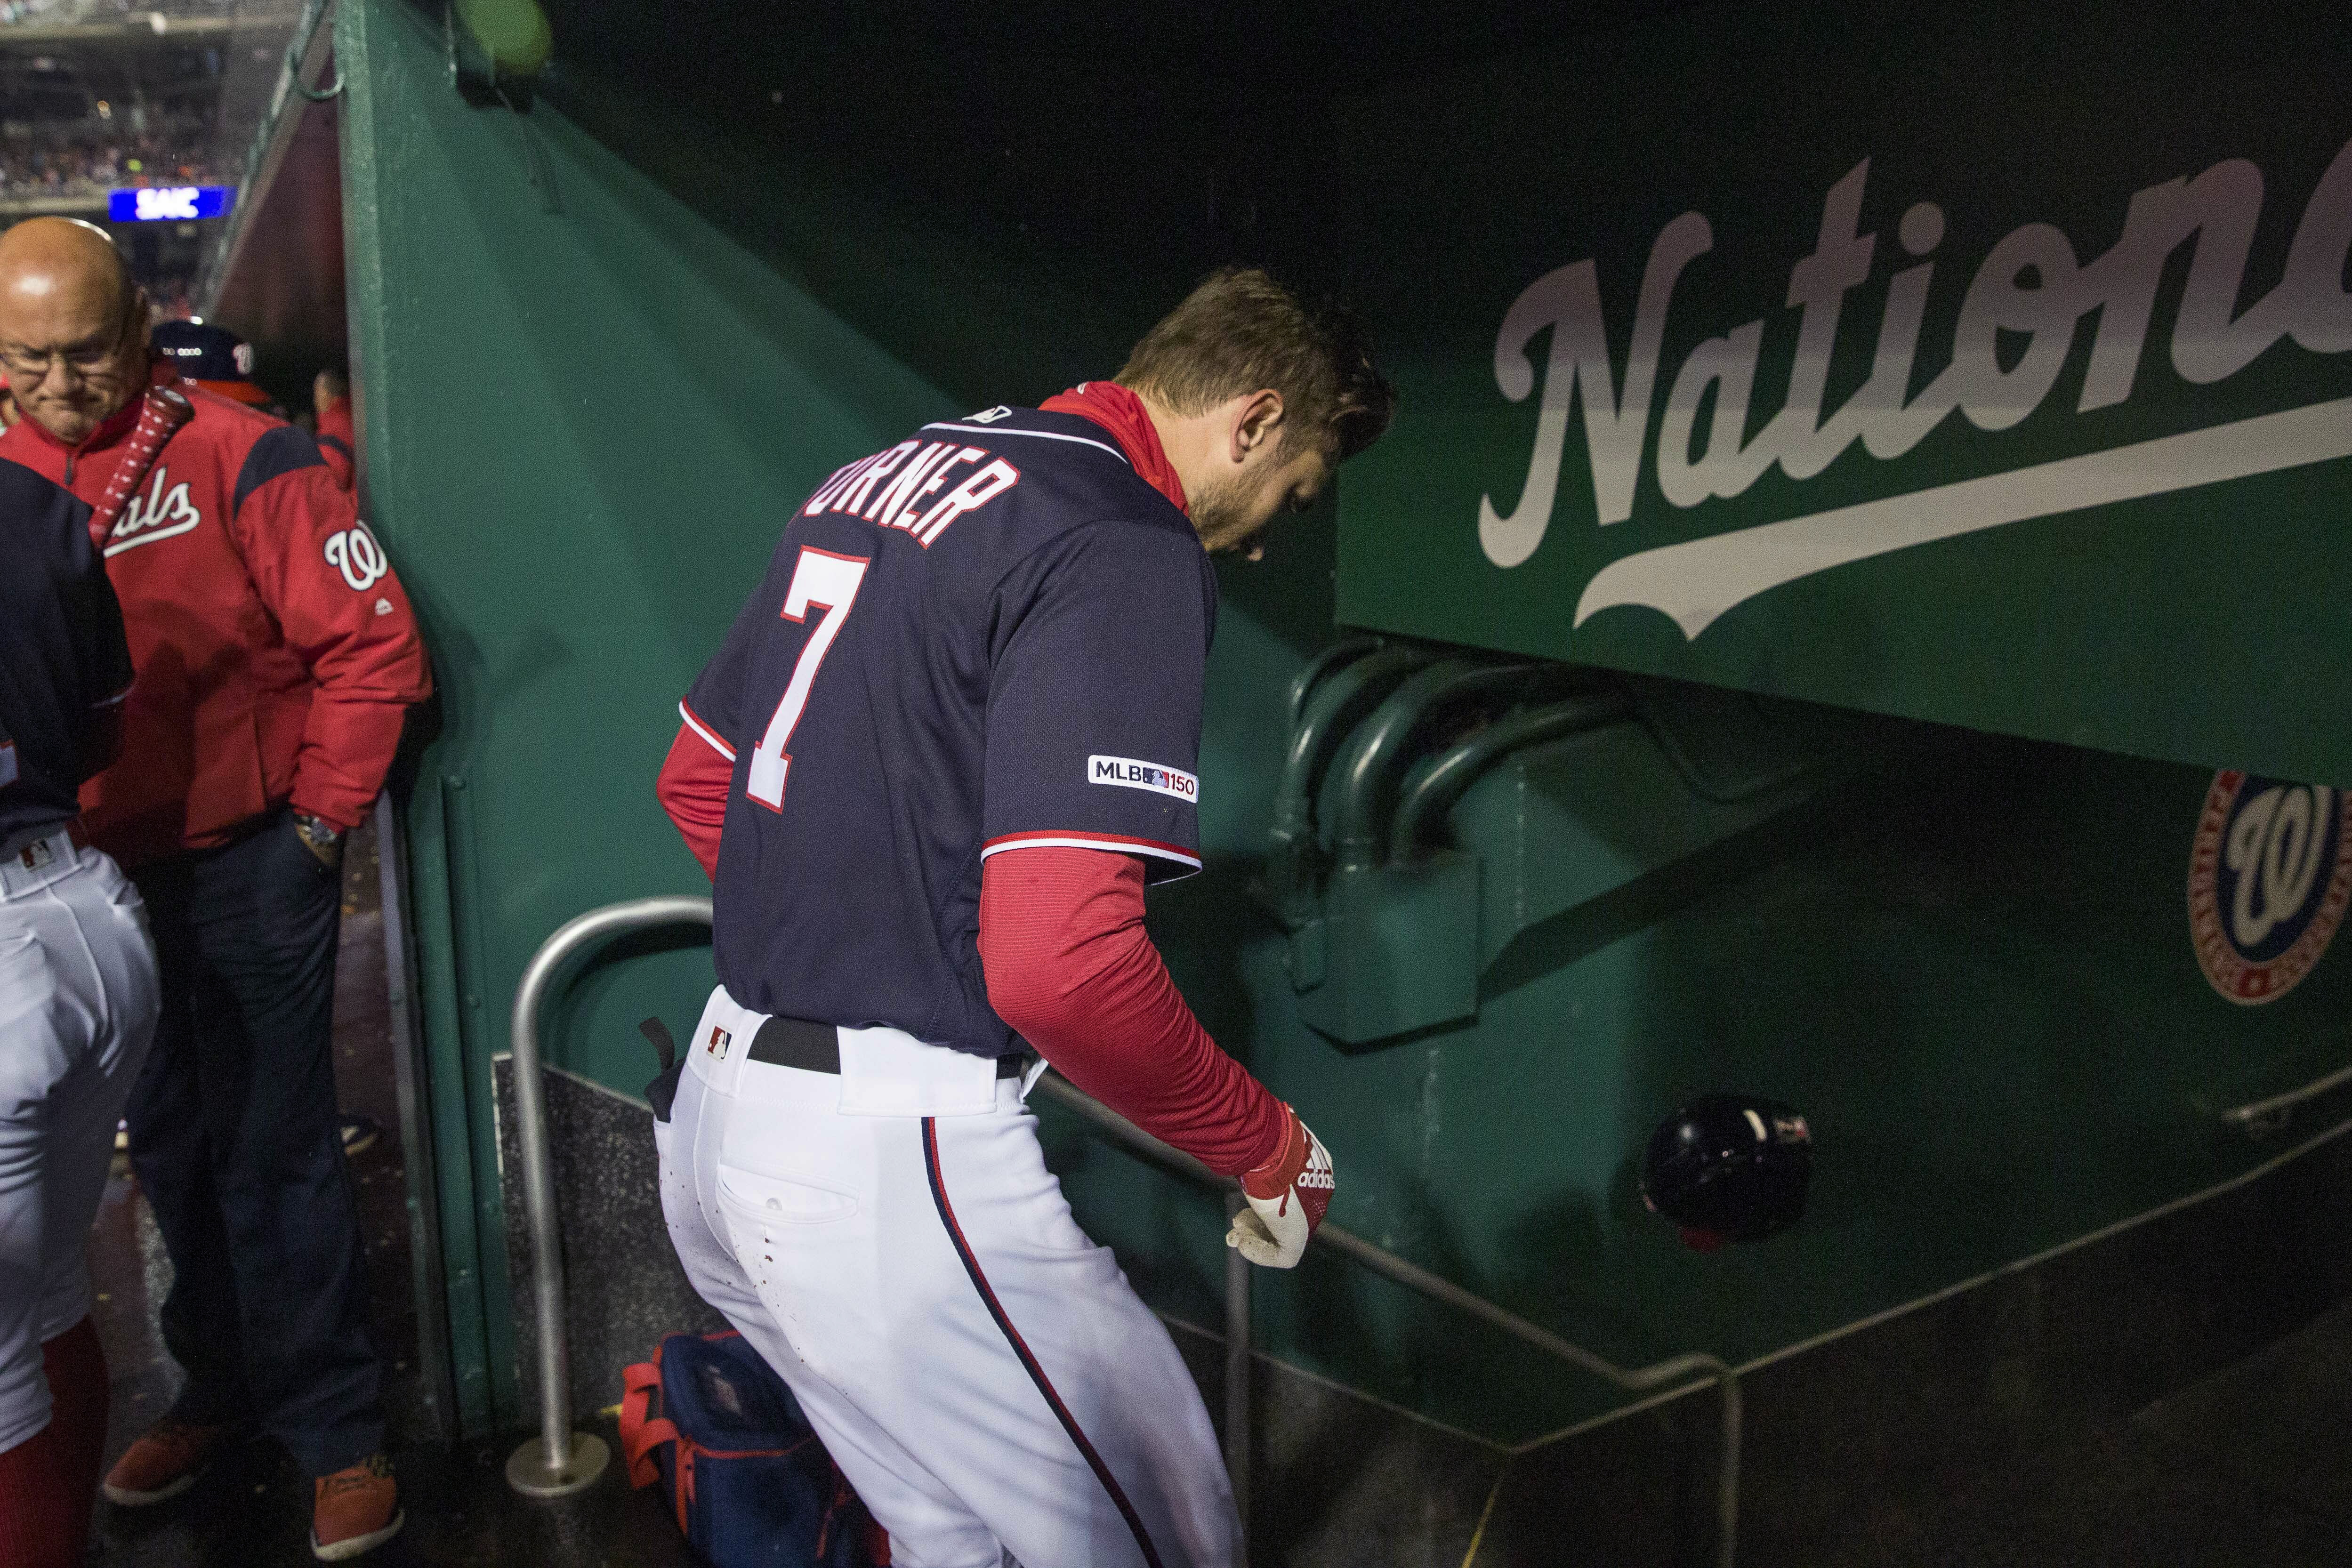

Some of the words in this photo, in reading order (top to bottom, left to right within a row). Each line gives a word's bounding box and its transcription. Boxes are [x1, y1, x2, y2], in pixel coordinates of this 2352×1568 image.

[746, 545, 870, 815] 7
[1096, 761, 1142, 781] MLB
[1171, 773, 1194, 795] 150
[1297, 1168, 1335, 1190] adidas
